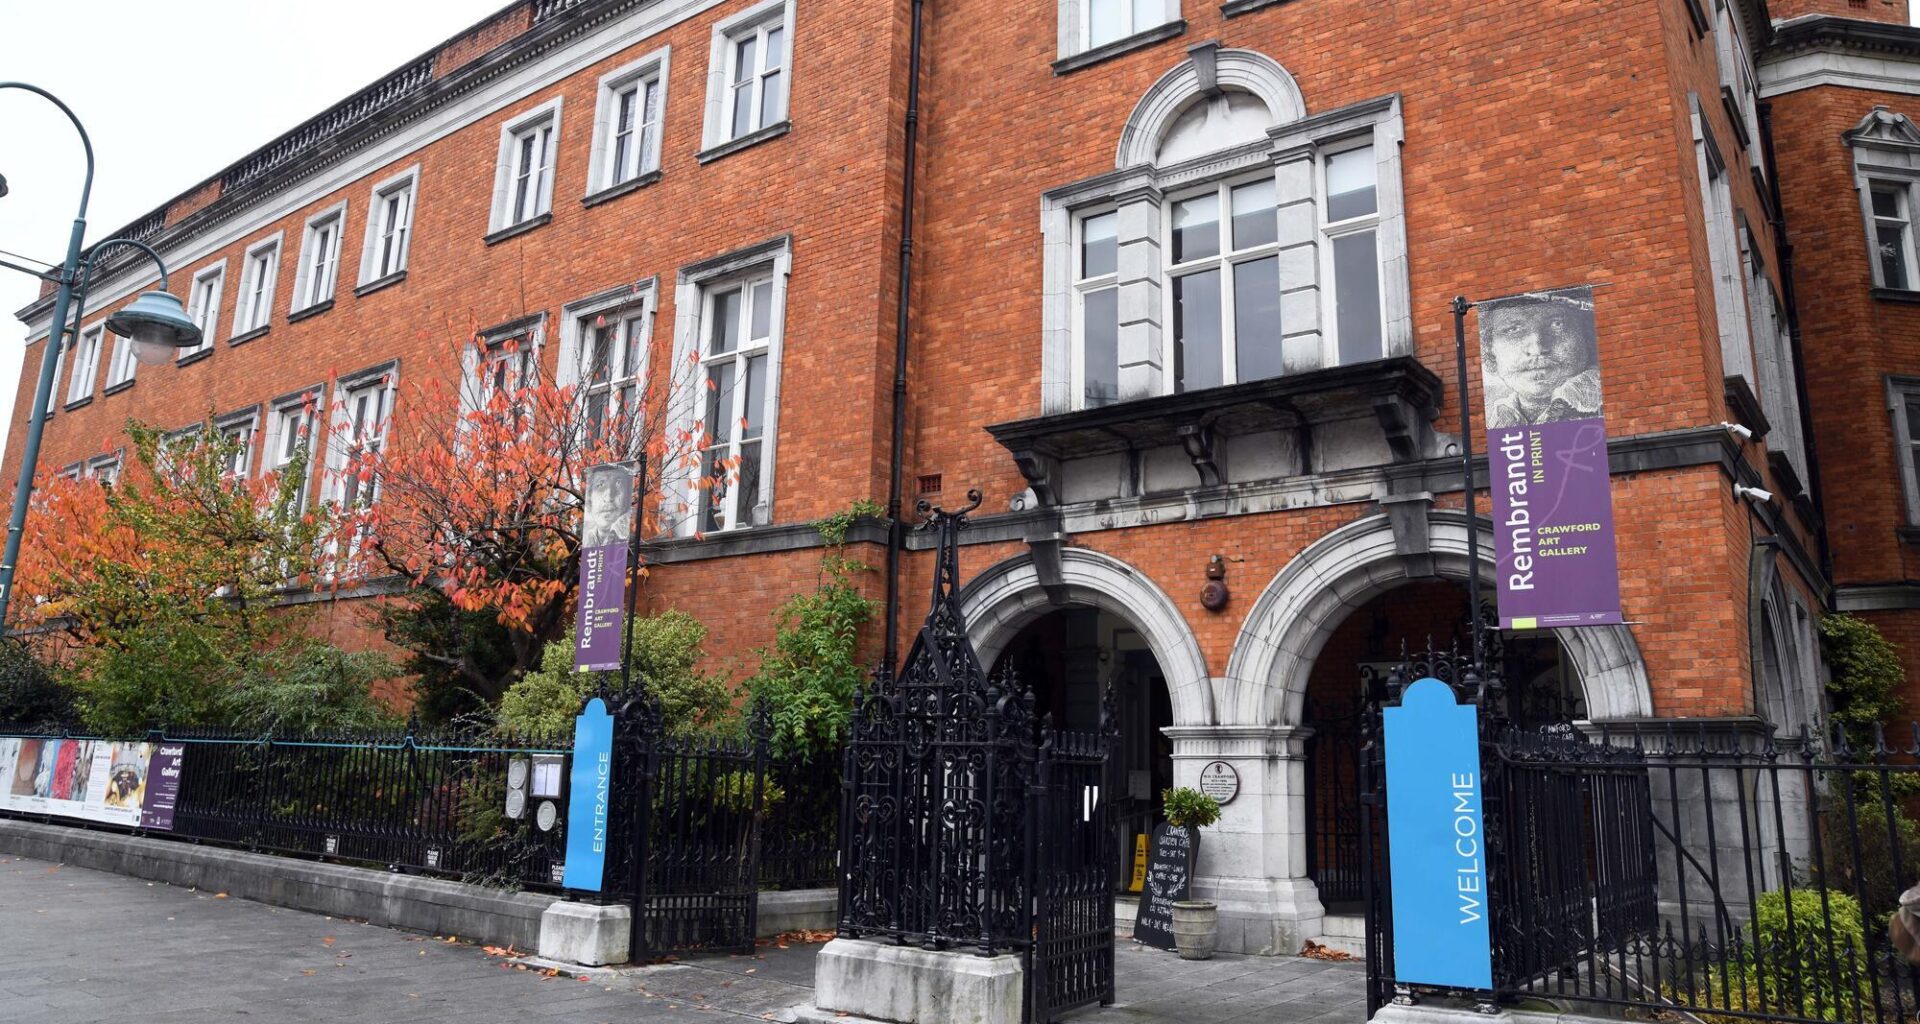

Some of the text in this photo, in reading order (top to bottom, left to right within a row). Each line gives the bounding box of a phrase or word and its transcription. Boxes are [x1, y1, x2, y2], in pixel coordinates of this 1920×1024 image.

[1529, 430, 1544, 483] IN PRINT
[1500, 431, 1534, 591] Rembrandt
[1537, 523, 1600, 535] CRAWFORD
[1538, 537, 1560, 546] ART
[1539, 546, 1587, 557] GALLERY
[597, 574, 602, 583] IN
[581, 550, 598, 649] Rembrandt
[160, 746, 183, 756] Crawford
[171, 757, 181, 766] Art
[161, 767, 180, 779] Gallery
[593, 752, 608, 853] ENTRANCE
[1452, 772, 1481, 925] WELCOME
